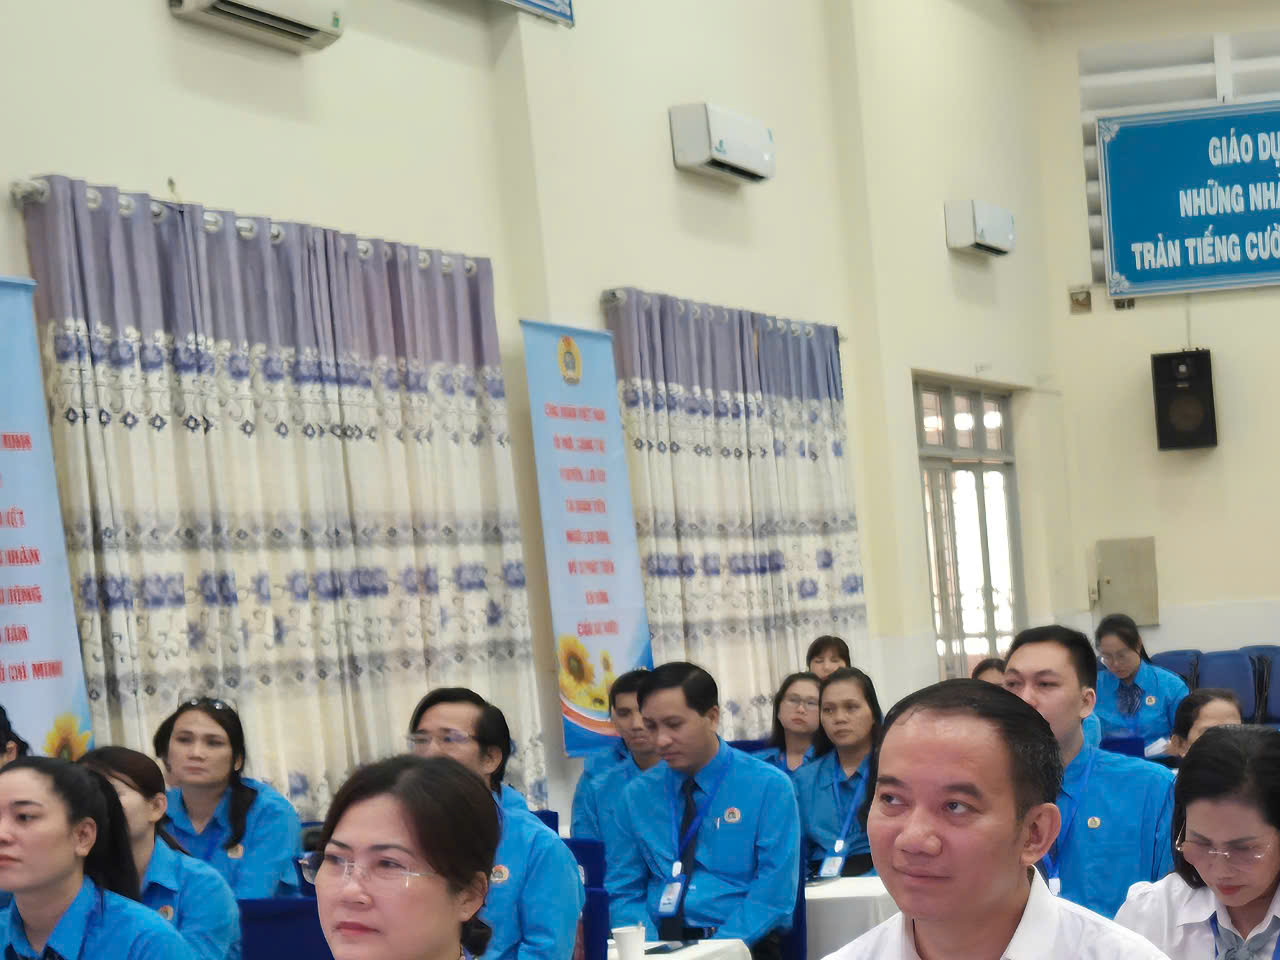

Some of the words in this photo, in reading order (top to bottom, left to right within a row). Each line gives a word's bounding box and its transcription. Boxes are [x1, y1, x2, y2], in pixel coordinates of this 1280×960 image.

[1207, 127, 1254, 167] GIÁO
[1178, 178, 1246, 218] NHỮNG
[1130, 232, 1182, 271] TRÀN
[1184, 223, 1242, 266] TIẾNG
